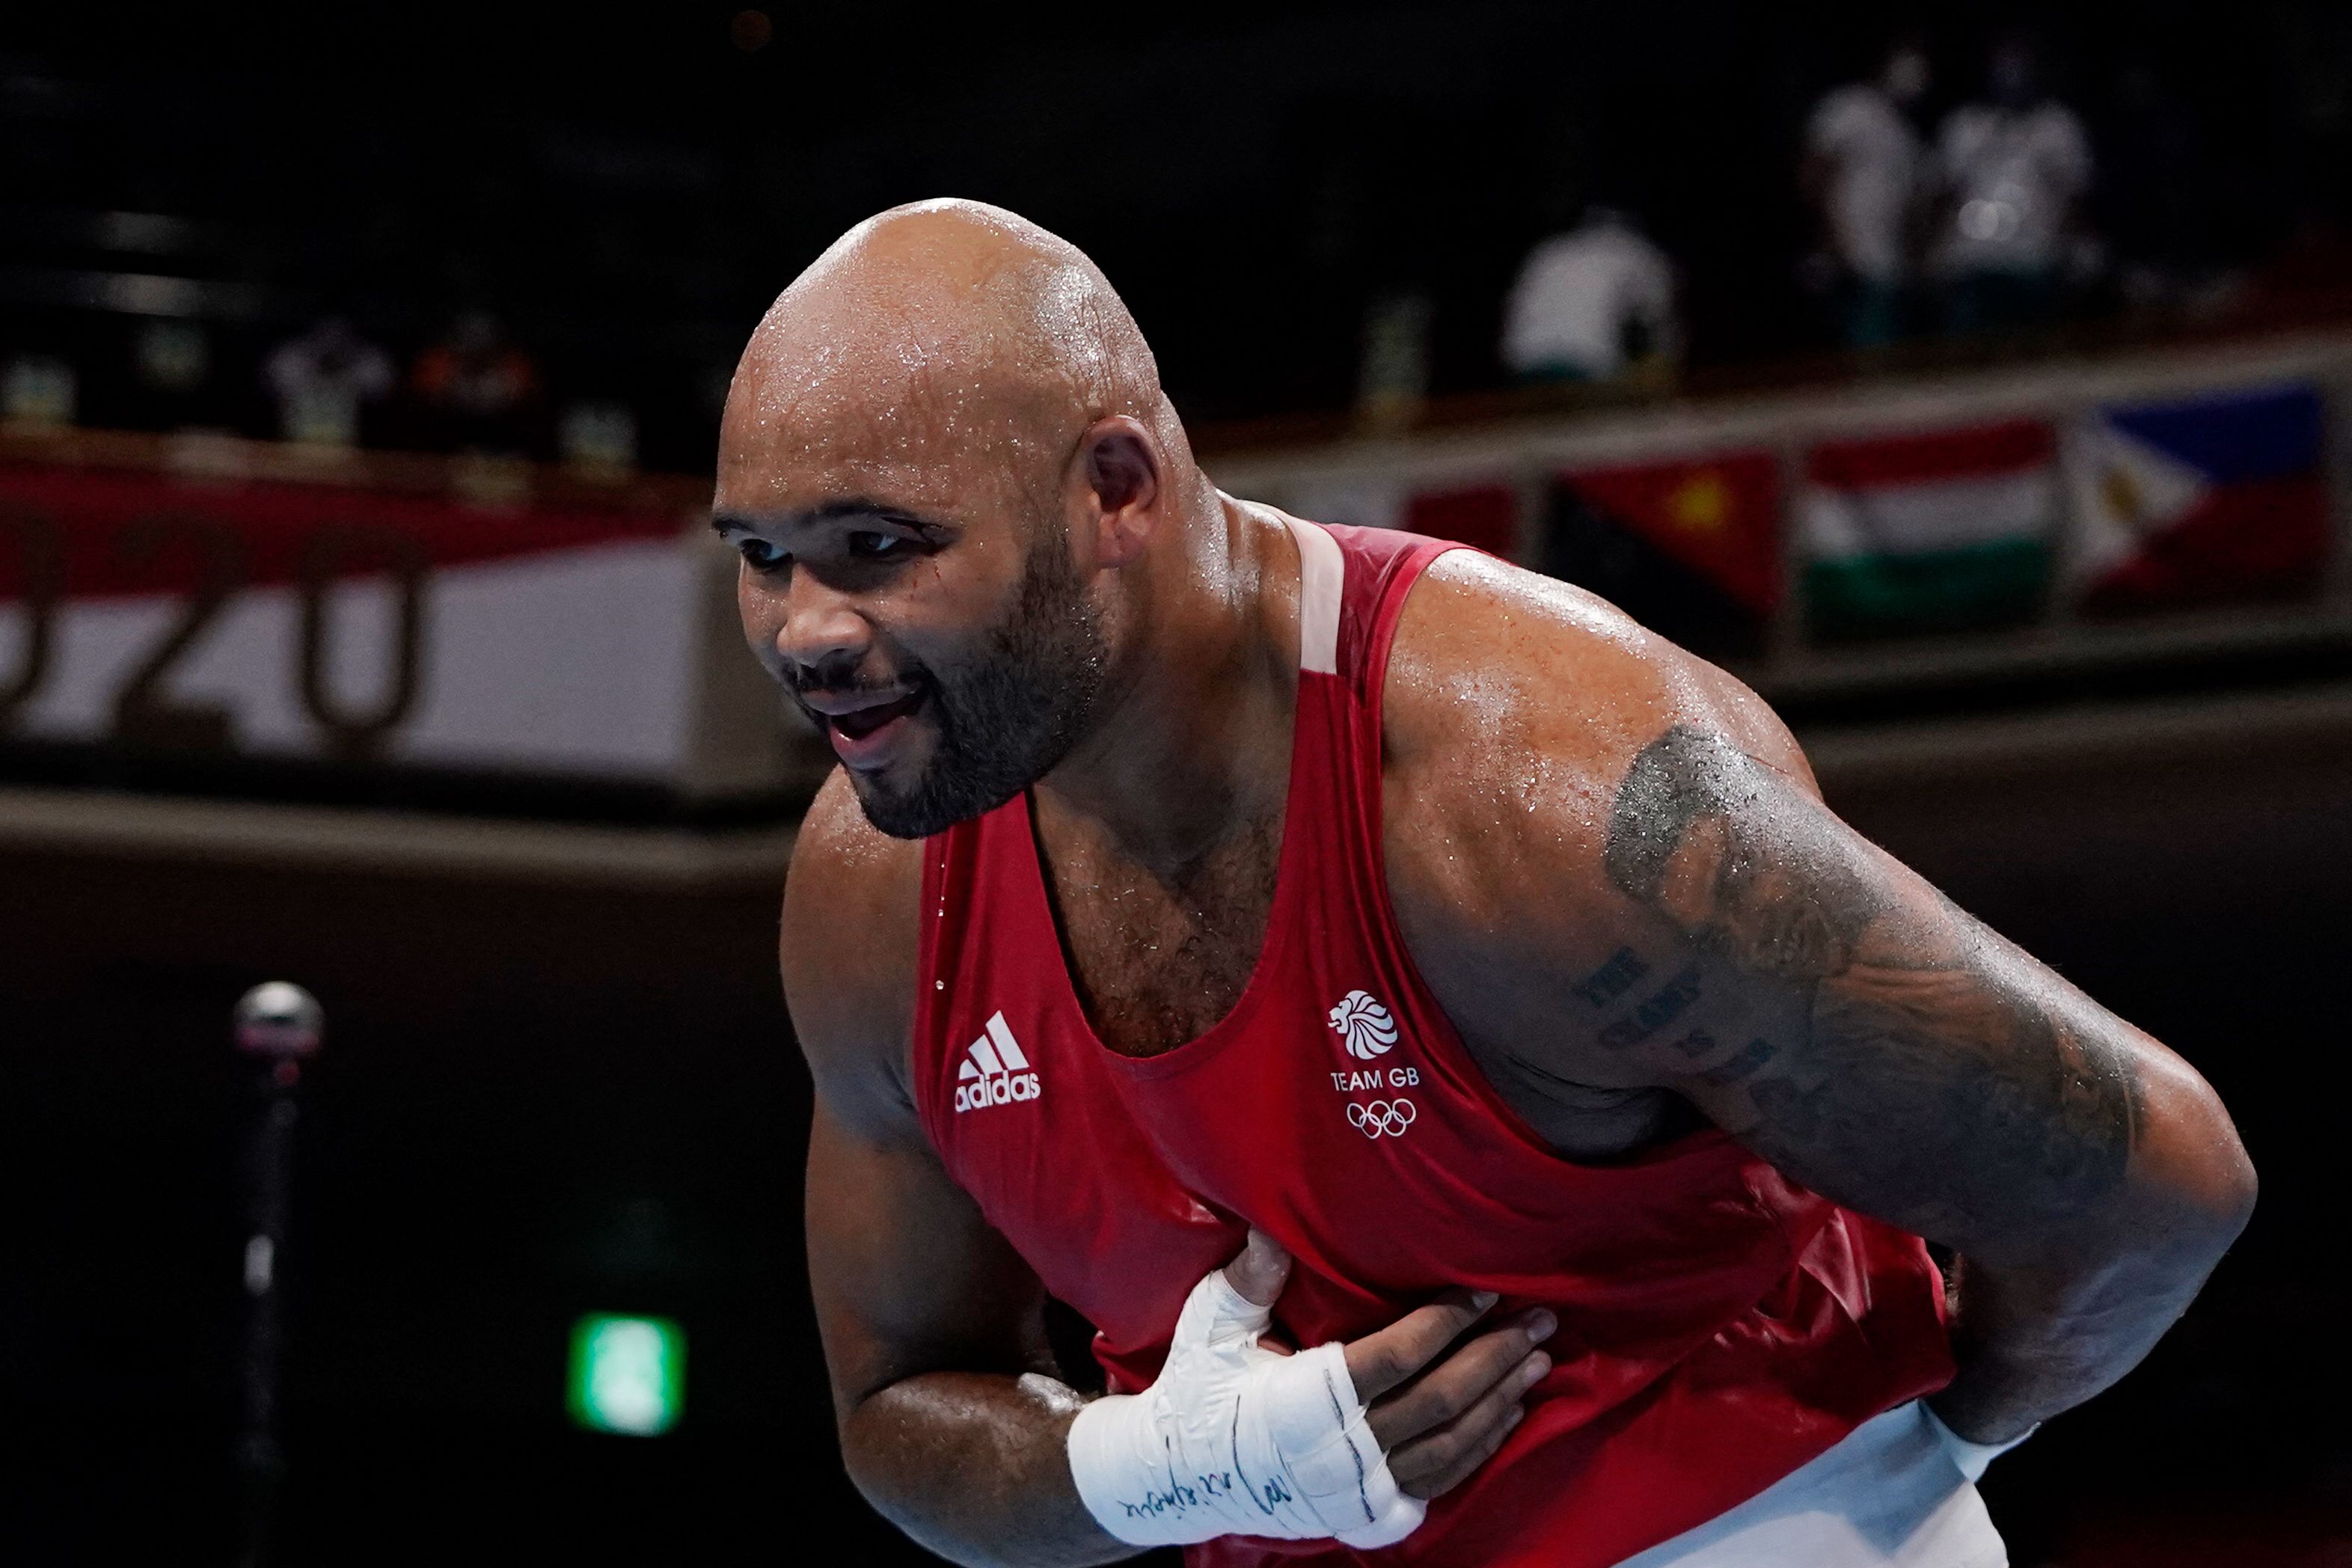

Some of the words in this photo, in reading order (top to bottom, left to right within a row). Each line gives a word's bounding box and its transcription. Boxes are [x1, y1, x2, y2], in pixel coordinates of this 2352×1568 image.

[955, 1070, 1041, 1112] adidas
[1330, 1070, 1382, 1091] TEAM
[1388, 1067, 1420, 1087] GB
